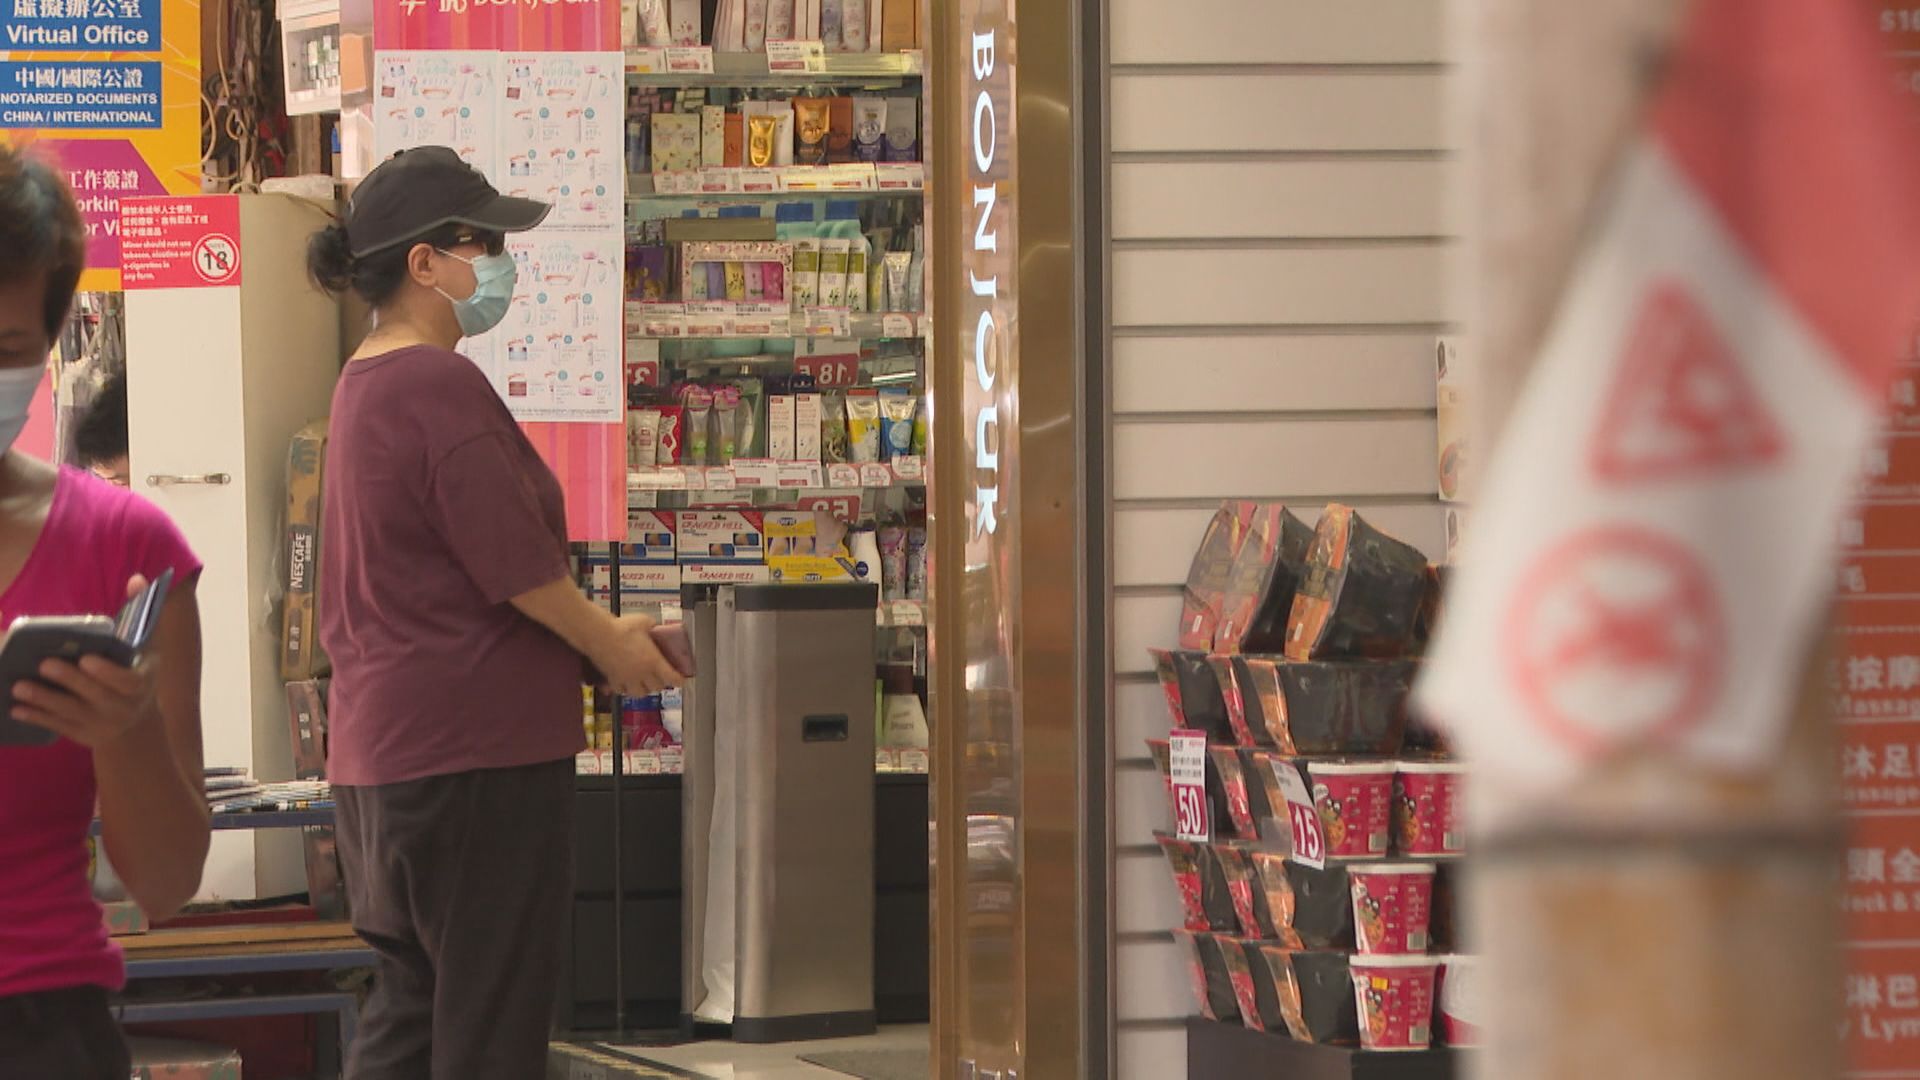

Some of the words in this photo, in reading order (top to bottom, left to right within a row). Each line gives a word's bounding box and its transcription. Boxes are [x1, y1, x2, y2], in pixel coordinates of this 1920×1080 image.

[6, 25, 78, 44] Virtual
[84, 25, 150, 44] Office
[15, 67, 143, 88] 中國/國際公證
[0, 93, 73, 105] NOTARIZED
[76, 93, 158, 105] DOCUMENTS
[3, 111, 43, 122] CHINA
[53, 111, 155, 122] INTERNATIONAL
[76, 195, 119, 212] orkin
[103, 219, 120, 236] Vi
[203, 251, 228, 270] 18
[970, 28, 999, 536] BONJOUR
[1842, 744, 1920, 780] 沐足
[1178, 787, 1200, 834] 50
[1294, 805, 1319, 859] 15
[1861, 1013, 1920, 1043] Lym
